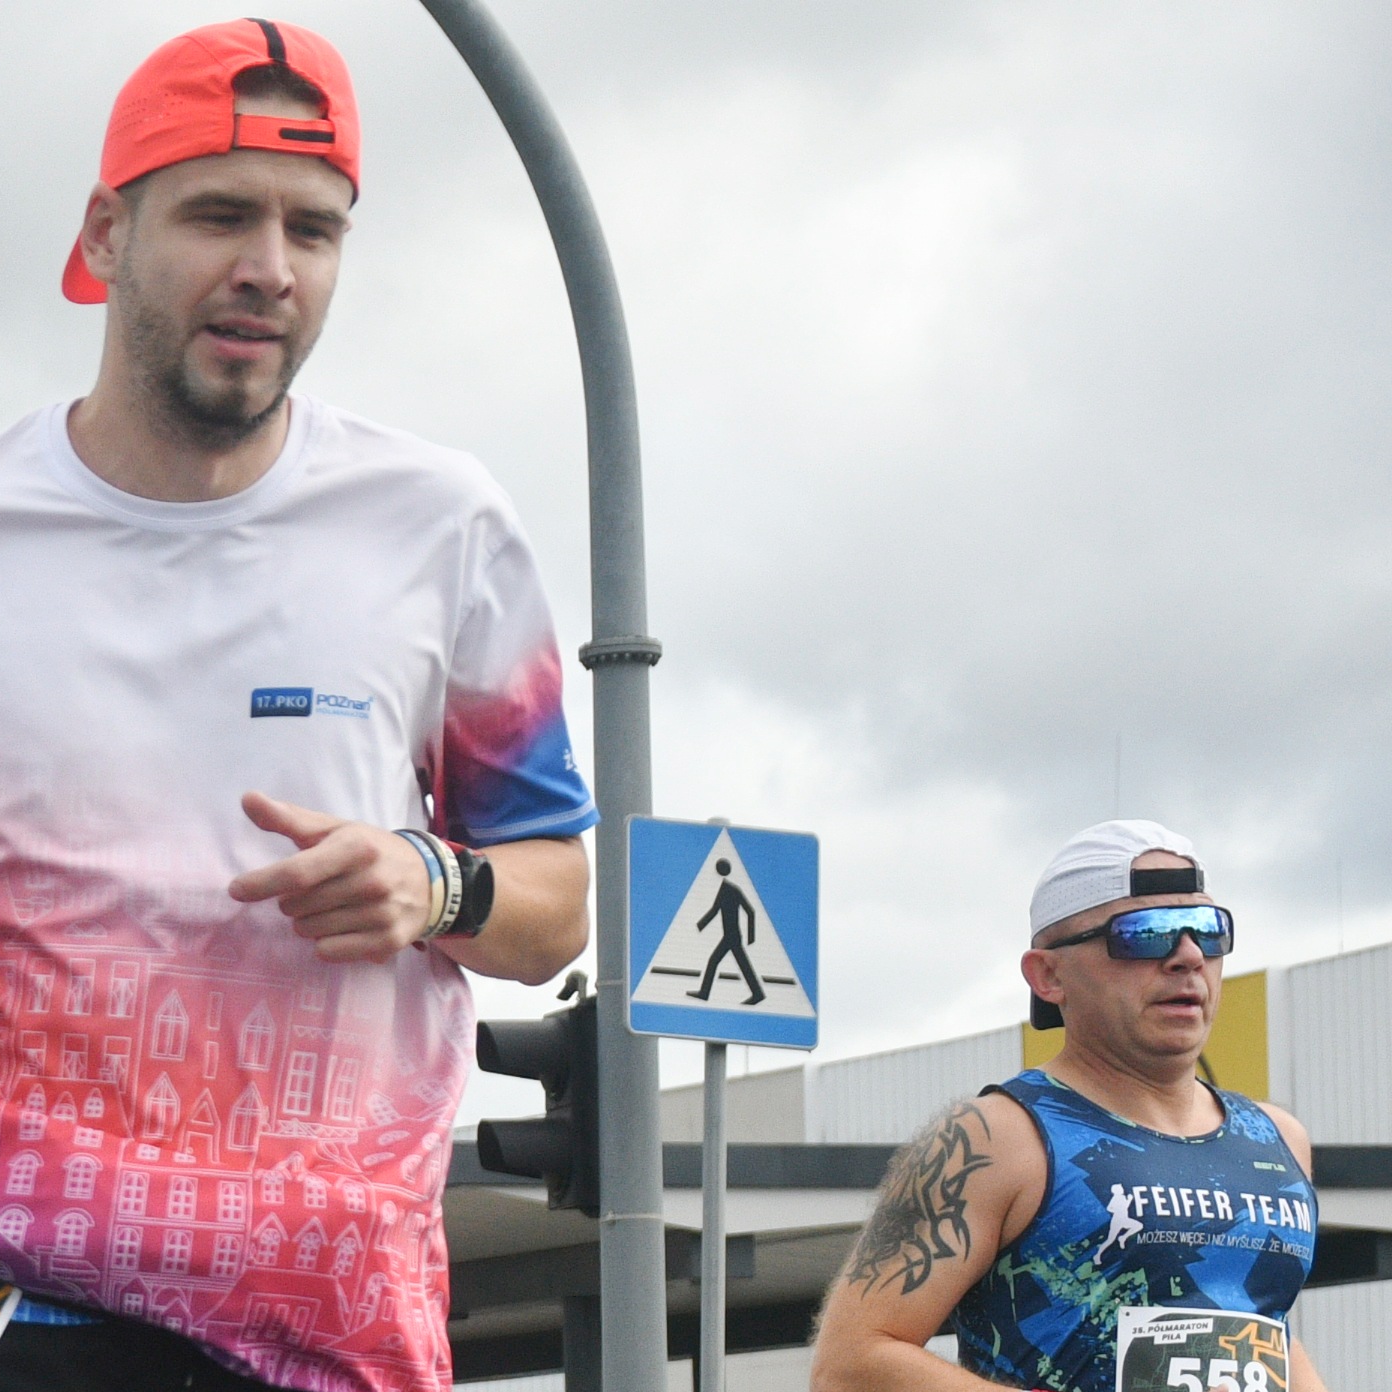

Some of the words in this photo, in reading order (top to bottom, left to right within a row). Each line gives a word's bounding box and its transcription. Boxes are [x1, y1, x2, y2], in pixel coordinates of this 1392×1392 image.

[276, 694, 308, 708] PKO
[1132, 1185, 1234, 1221] FEIFER
[1240, 1192, 1312, 1233] TEAM
[1136, 1229, 1179, 1245] MOŻESZ
[1179, 1232, 1211, 1247] WIĘCEJ
[1211, 1232, 1225, 1246] NIŻ
[1268, 1237, 1281, 1253] ŻE
[1131, 1326, 1146, 1335] 35.
[1147, 1322, 1209, 1334] PÓŁMARATON
[1161, 1332, 1182, 1342] PIŁA
